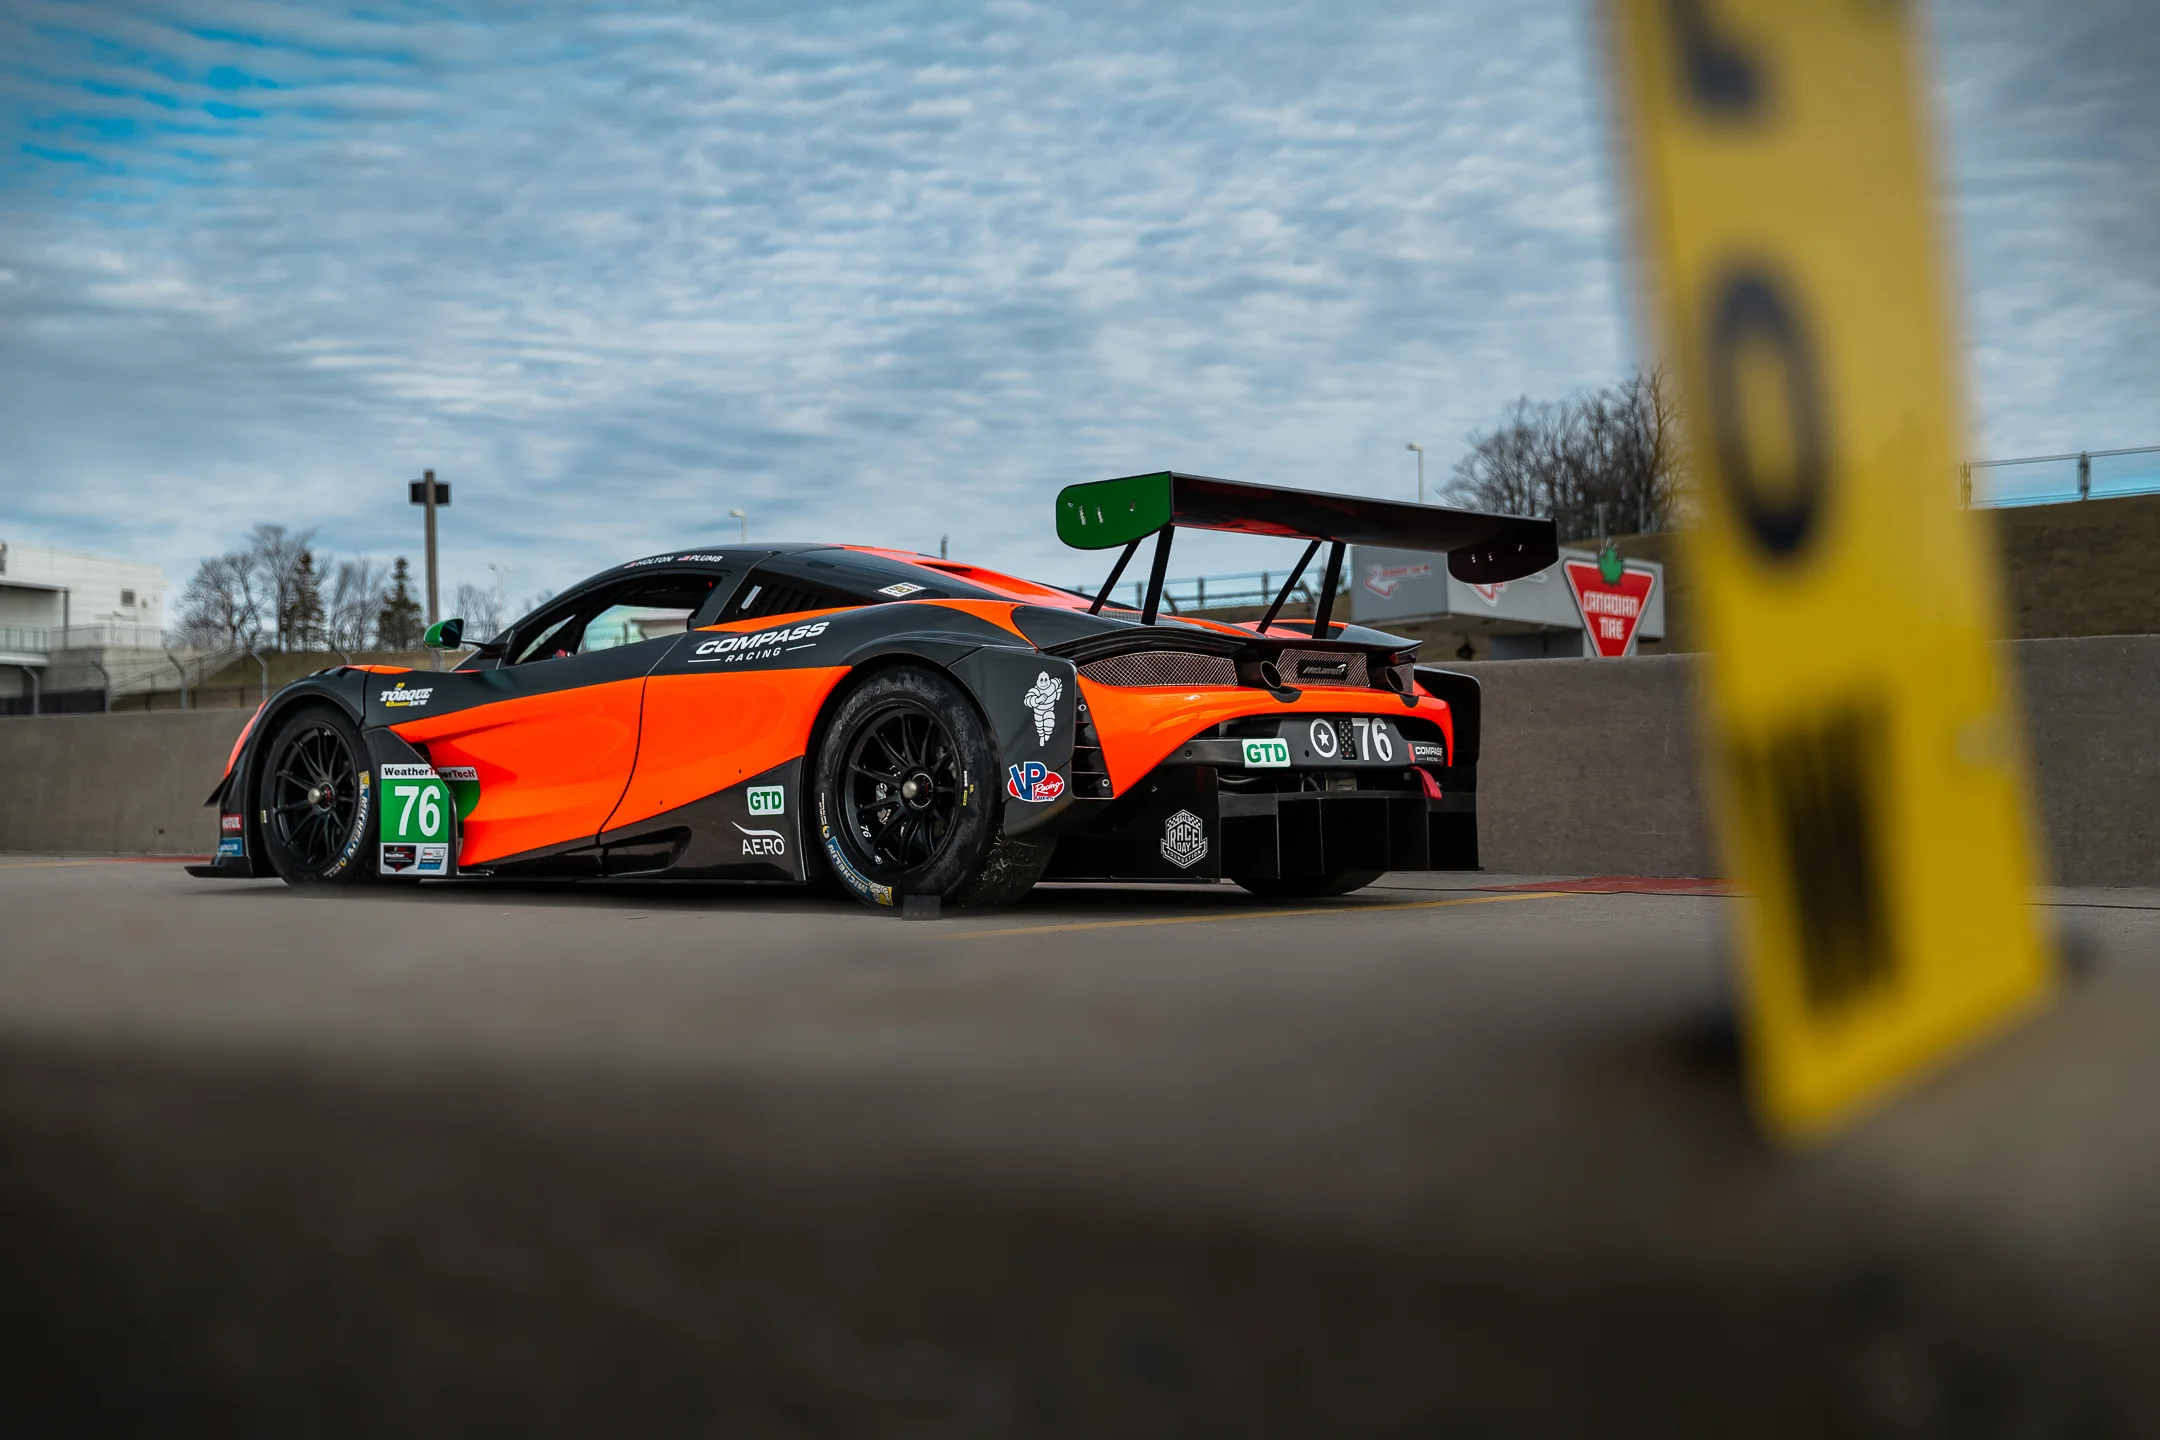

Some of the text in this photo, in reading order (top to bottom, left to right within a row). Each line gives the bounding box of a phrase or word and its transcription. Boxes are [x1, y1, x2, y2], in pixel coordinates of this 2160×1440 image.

[635, 555, 674, 567] HOLTON
[689, 554, 723, 563] PLUMB
[695, 621, 830, 655] COMPASS
[1598, 616, 1625, 641] TIRE
[724, 647, 782, 663] RACING
[1302, 665, 1344, 676] McLaren
[379, 687, 434, 702] TORQUE
[1350, 716, 1393, 762] 76
[1246, 743, 1287, 763] GTD
[384, 767, 440, 776] WeatherT
[1009, 761, 1047, 800] VP
[394, 785, 441, 837] 76
[749, 791, 783, 811] GTD
[1170, 823, 1199, 850] RACE
[742, 838, 785, 856] AERO
[827, 843, 869, 894] MICHELIN
